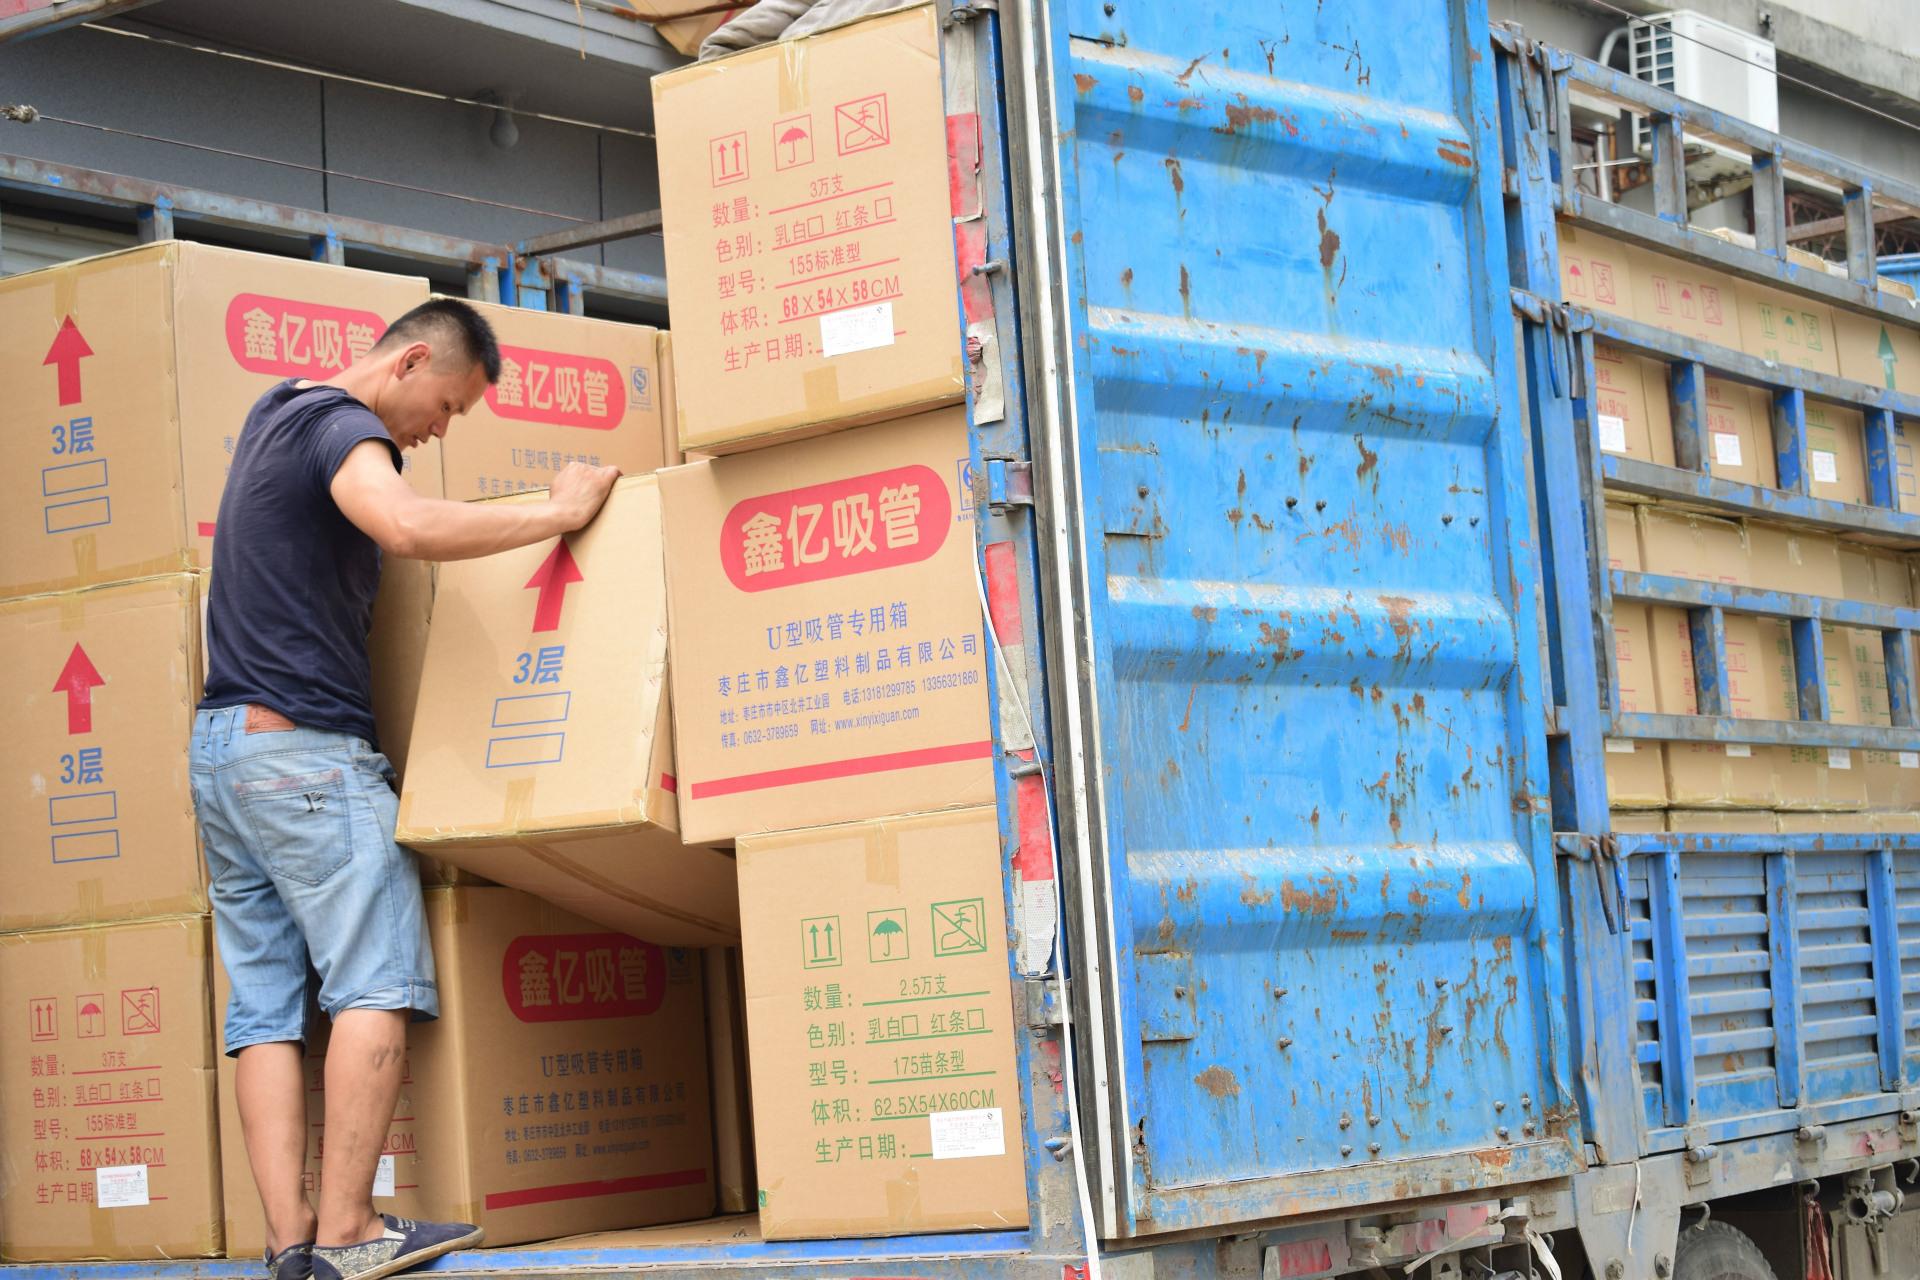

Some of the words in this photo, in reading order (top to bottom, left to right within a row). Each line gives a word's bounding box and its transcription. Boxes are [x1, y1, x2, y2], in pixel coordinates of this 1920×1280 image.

[810, 172, 844, 198] 3万支
[789, 241, 863, 276] 155标准型
[495, 357, 609, 418] 鑫亿吸管
[51, 415, 96, 456] 3层
[741, 482, 923, 577] 鑫亿吸管
[767, 600, 909, 651] U型吸管专用箱
[512, 644, 566, 686] 3层
[718, 633, 978, 697] 枣庄市鑫亿塑料制品有限公司
[59, 746, 104, 786] 3层
[517, 945, 649, 1008] 鑫亿吸管
[899, 973, 948, 996] 2.5万支
[894, 1049, 966, 1076] 175苗条型
[86, 1112, 137, 1132] 155标准型
[874, 1088, 995, 1116] 62.5X54X60CM
